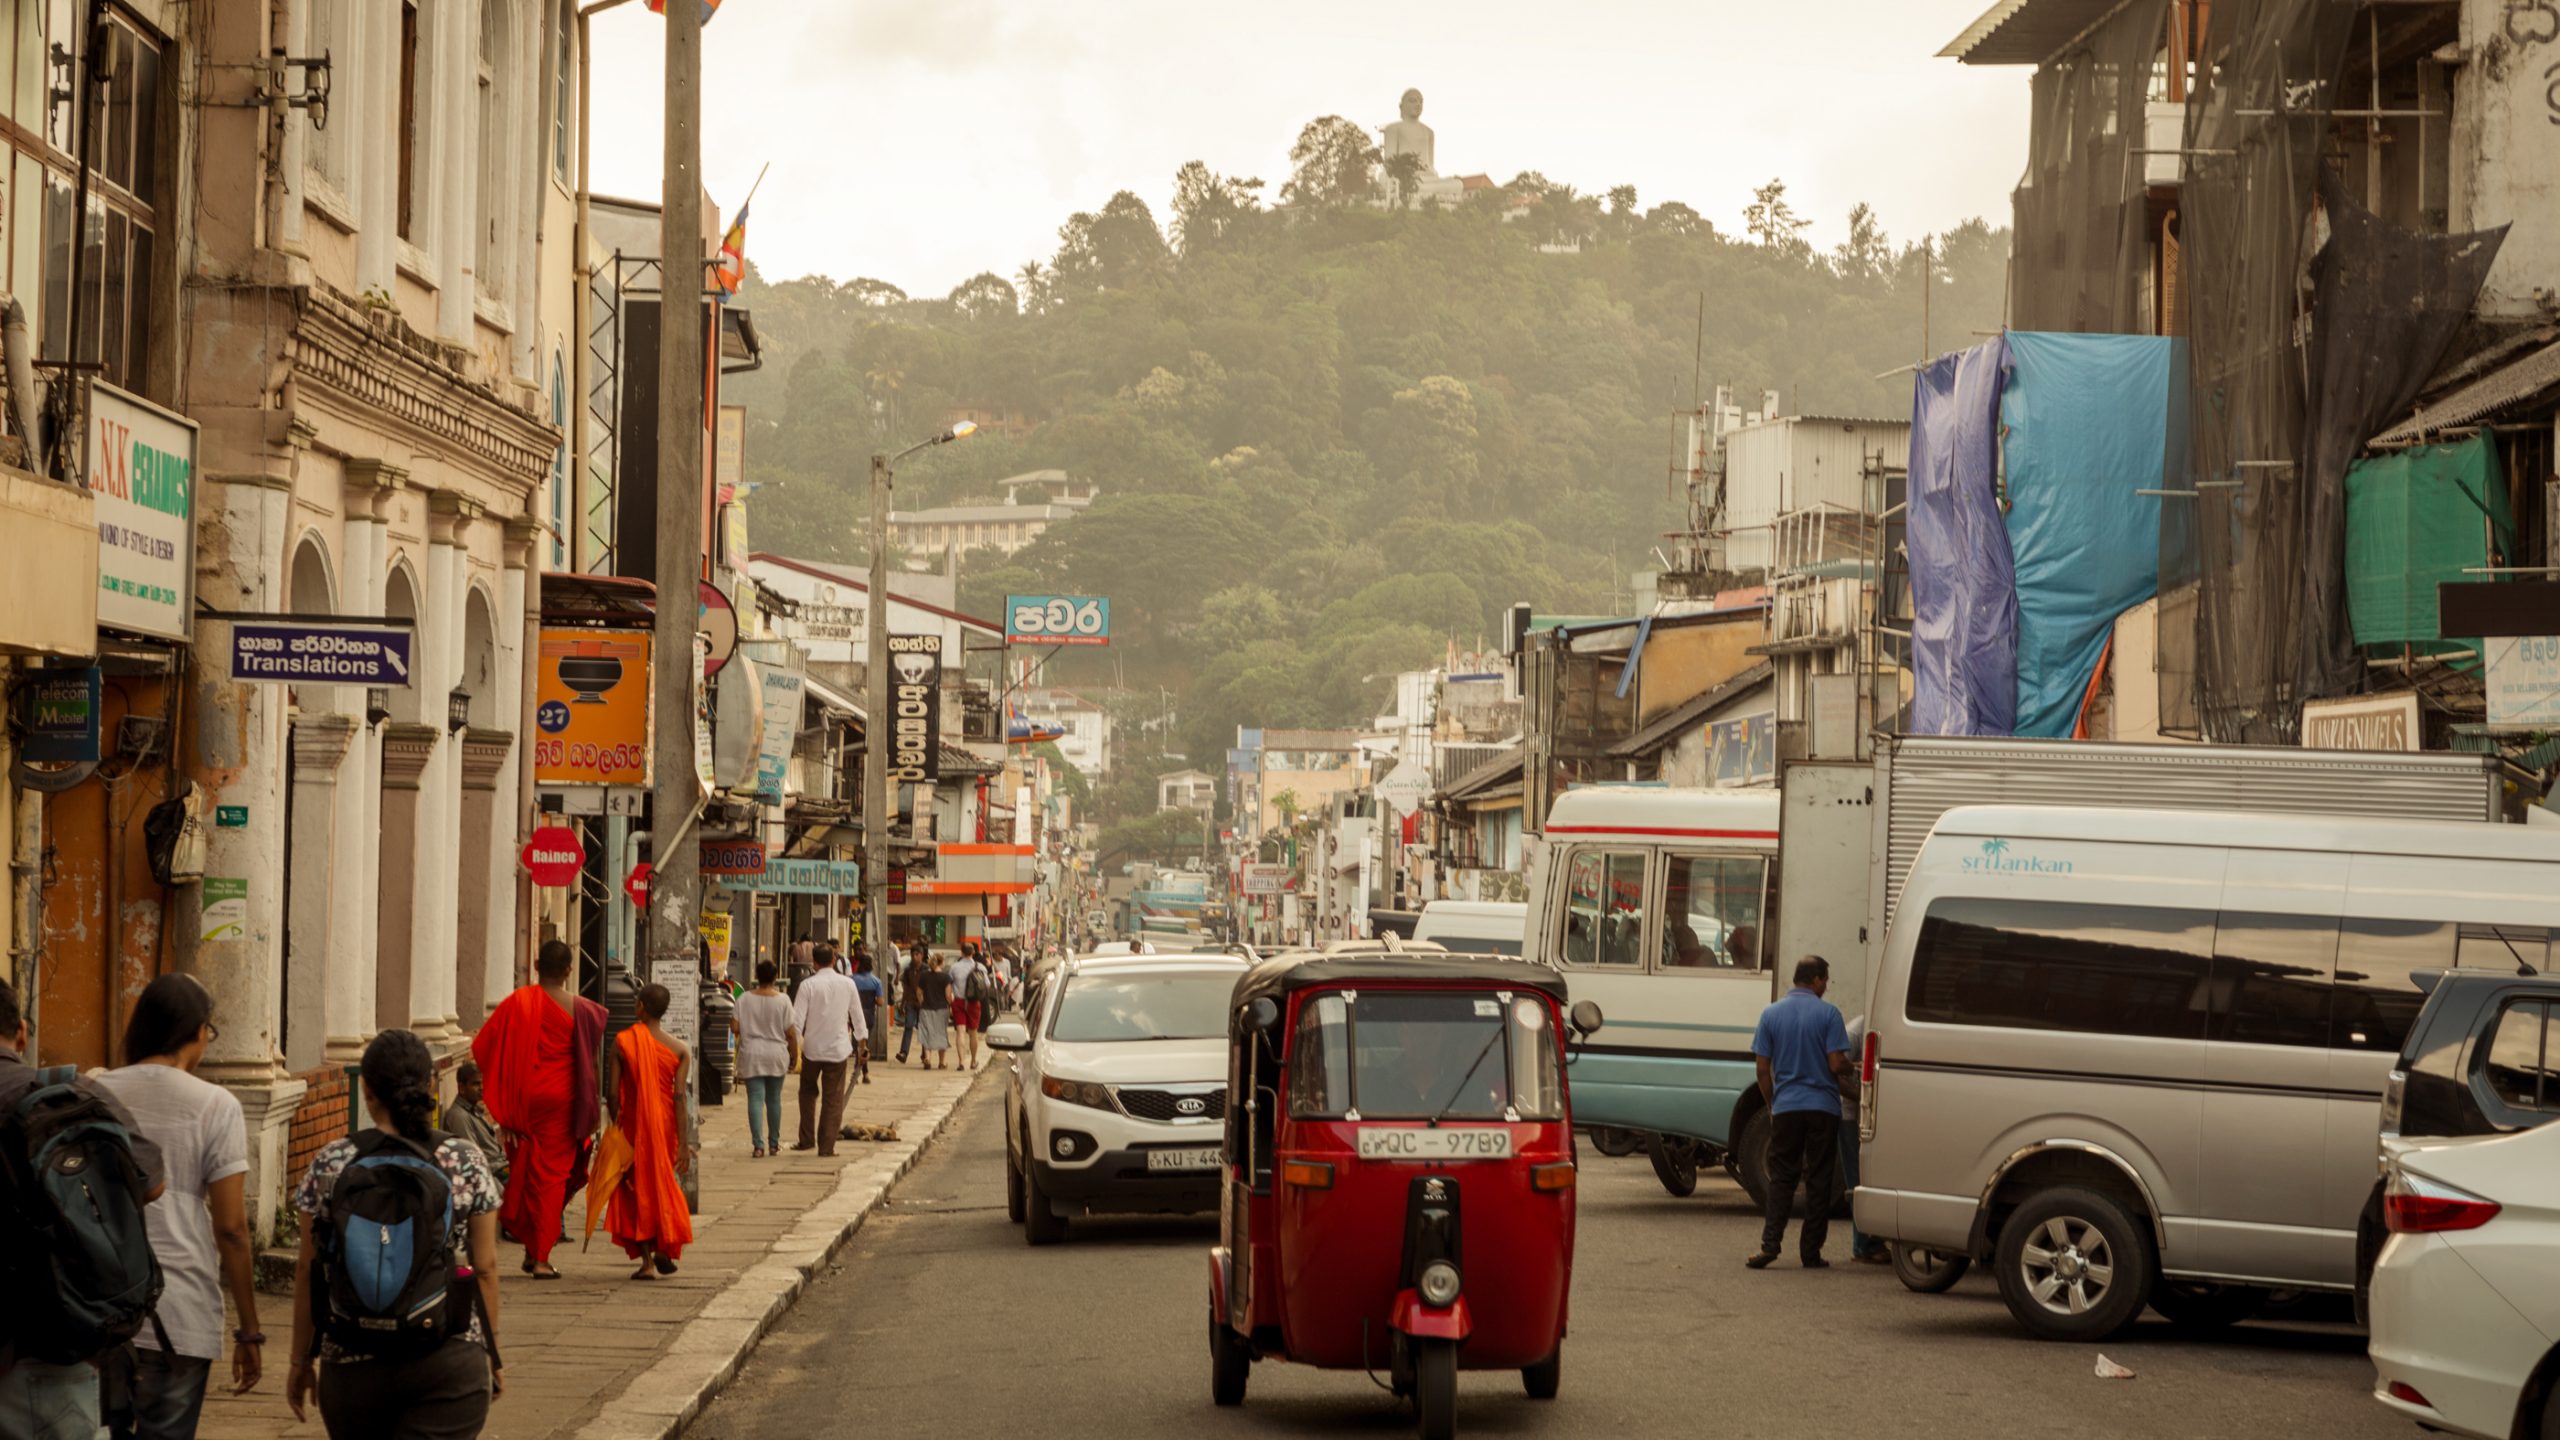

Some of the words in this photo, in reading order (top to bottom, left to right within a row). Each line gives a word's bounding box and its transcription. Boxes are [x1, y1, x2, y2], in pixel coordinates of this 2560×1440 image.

[131, 440, 189, 520] CERAMICS
[1014, 598, 1103, 635] පවර
[239, 652, 380, 676] Translations
[34, 682, 89, 700] Telecom
[38, 706, 85, 727] Mobitel
[540, 708, 567, 725] 27
[570, 744, 642, 774] ධවලගිරි
[532, 850, 577, 863] Rainco
[1182, 1101, 1200, 1111] KIA
[1386, 1132, 1417, 1154] QC
[1163, 1152, 1183, 1167] KU
